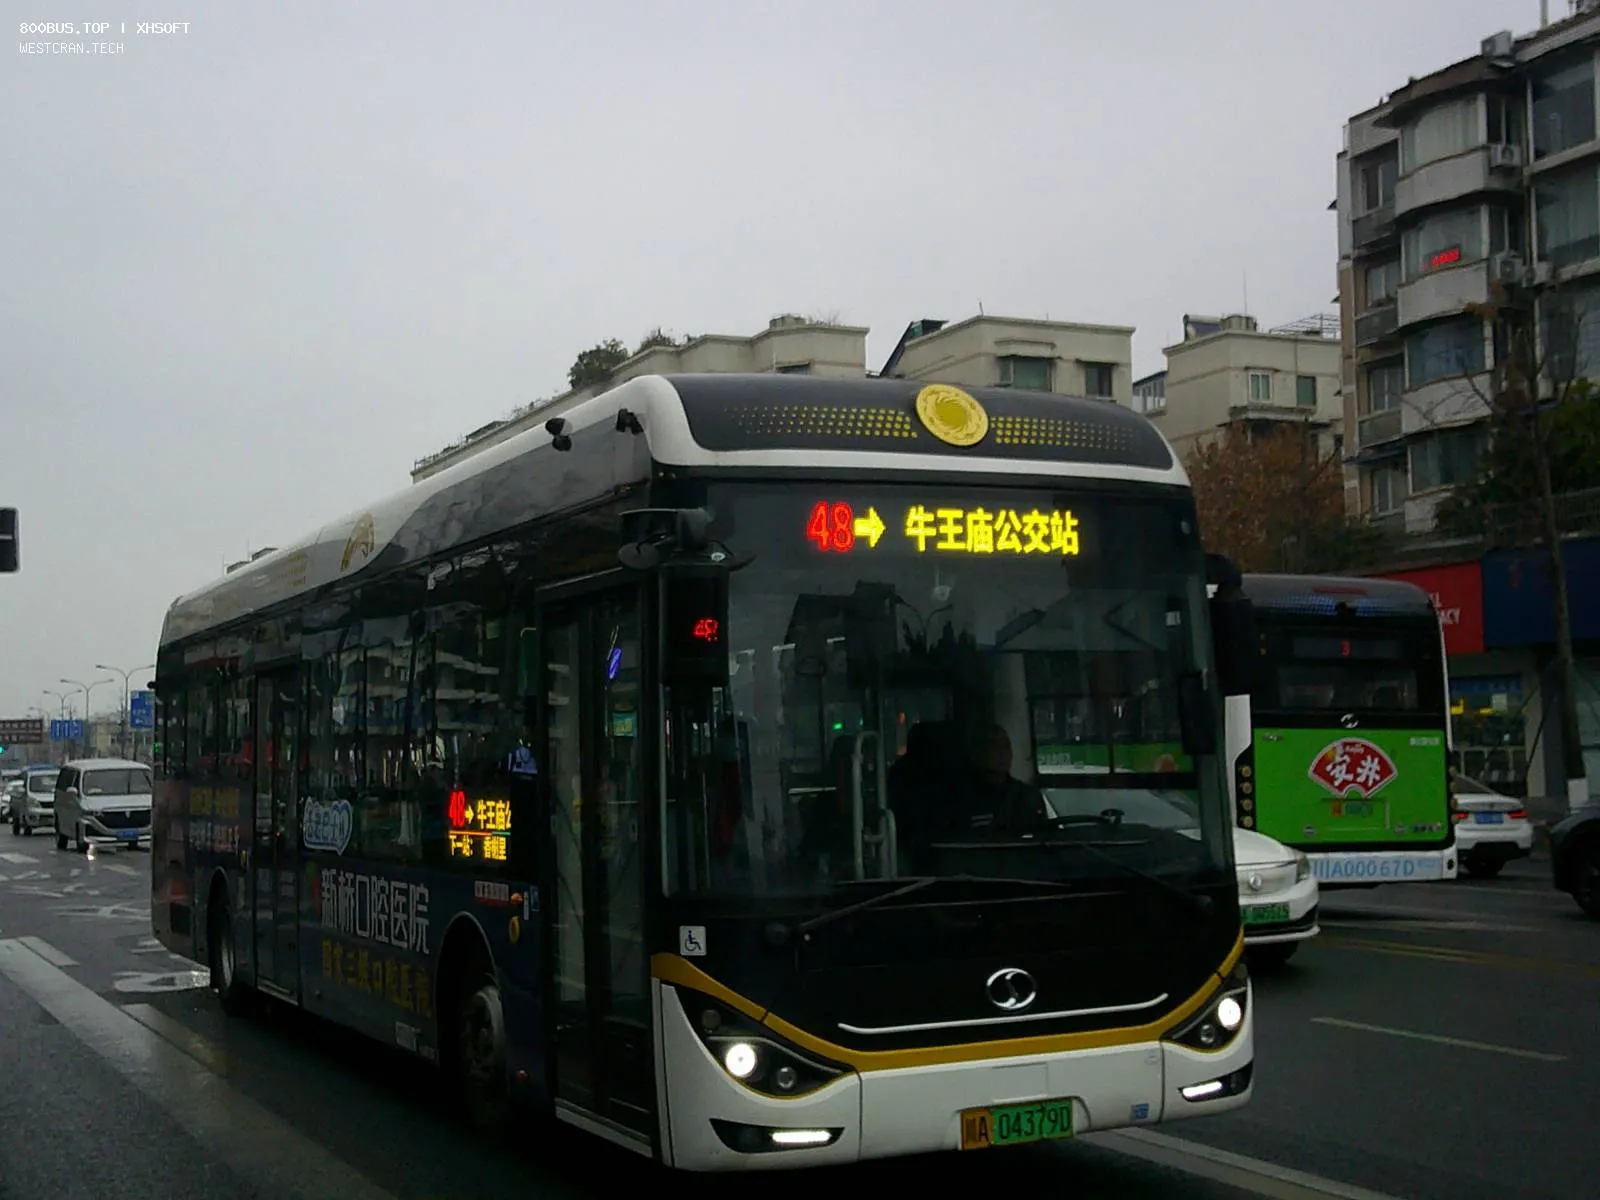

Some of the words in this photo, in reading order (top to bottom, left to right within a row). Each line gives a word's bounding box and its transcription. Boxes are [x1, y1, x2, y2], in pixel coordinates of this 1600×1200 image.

[806, 501, 855, 553] 48
[904, 504, 1079, 555] 牛王庙公交站
[448, 791, 466, 828] 48
